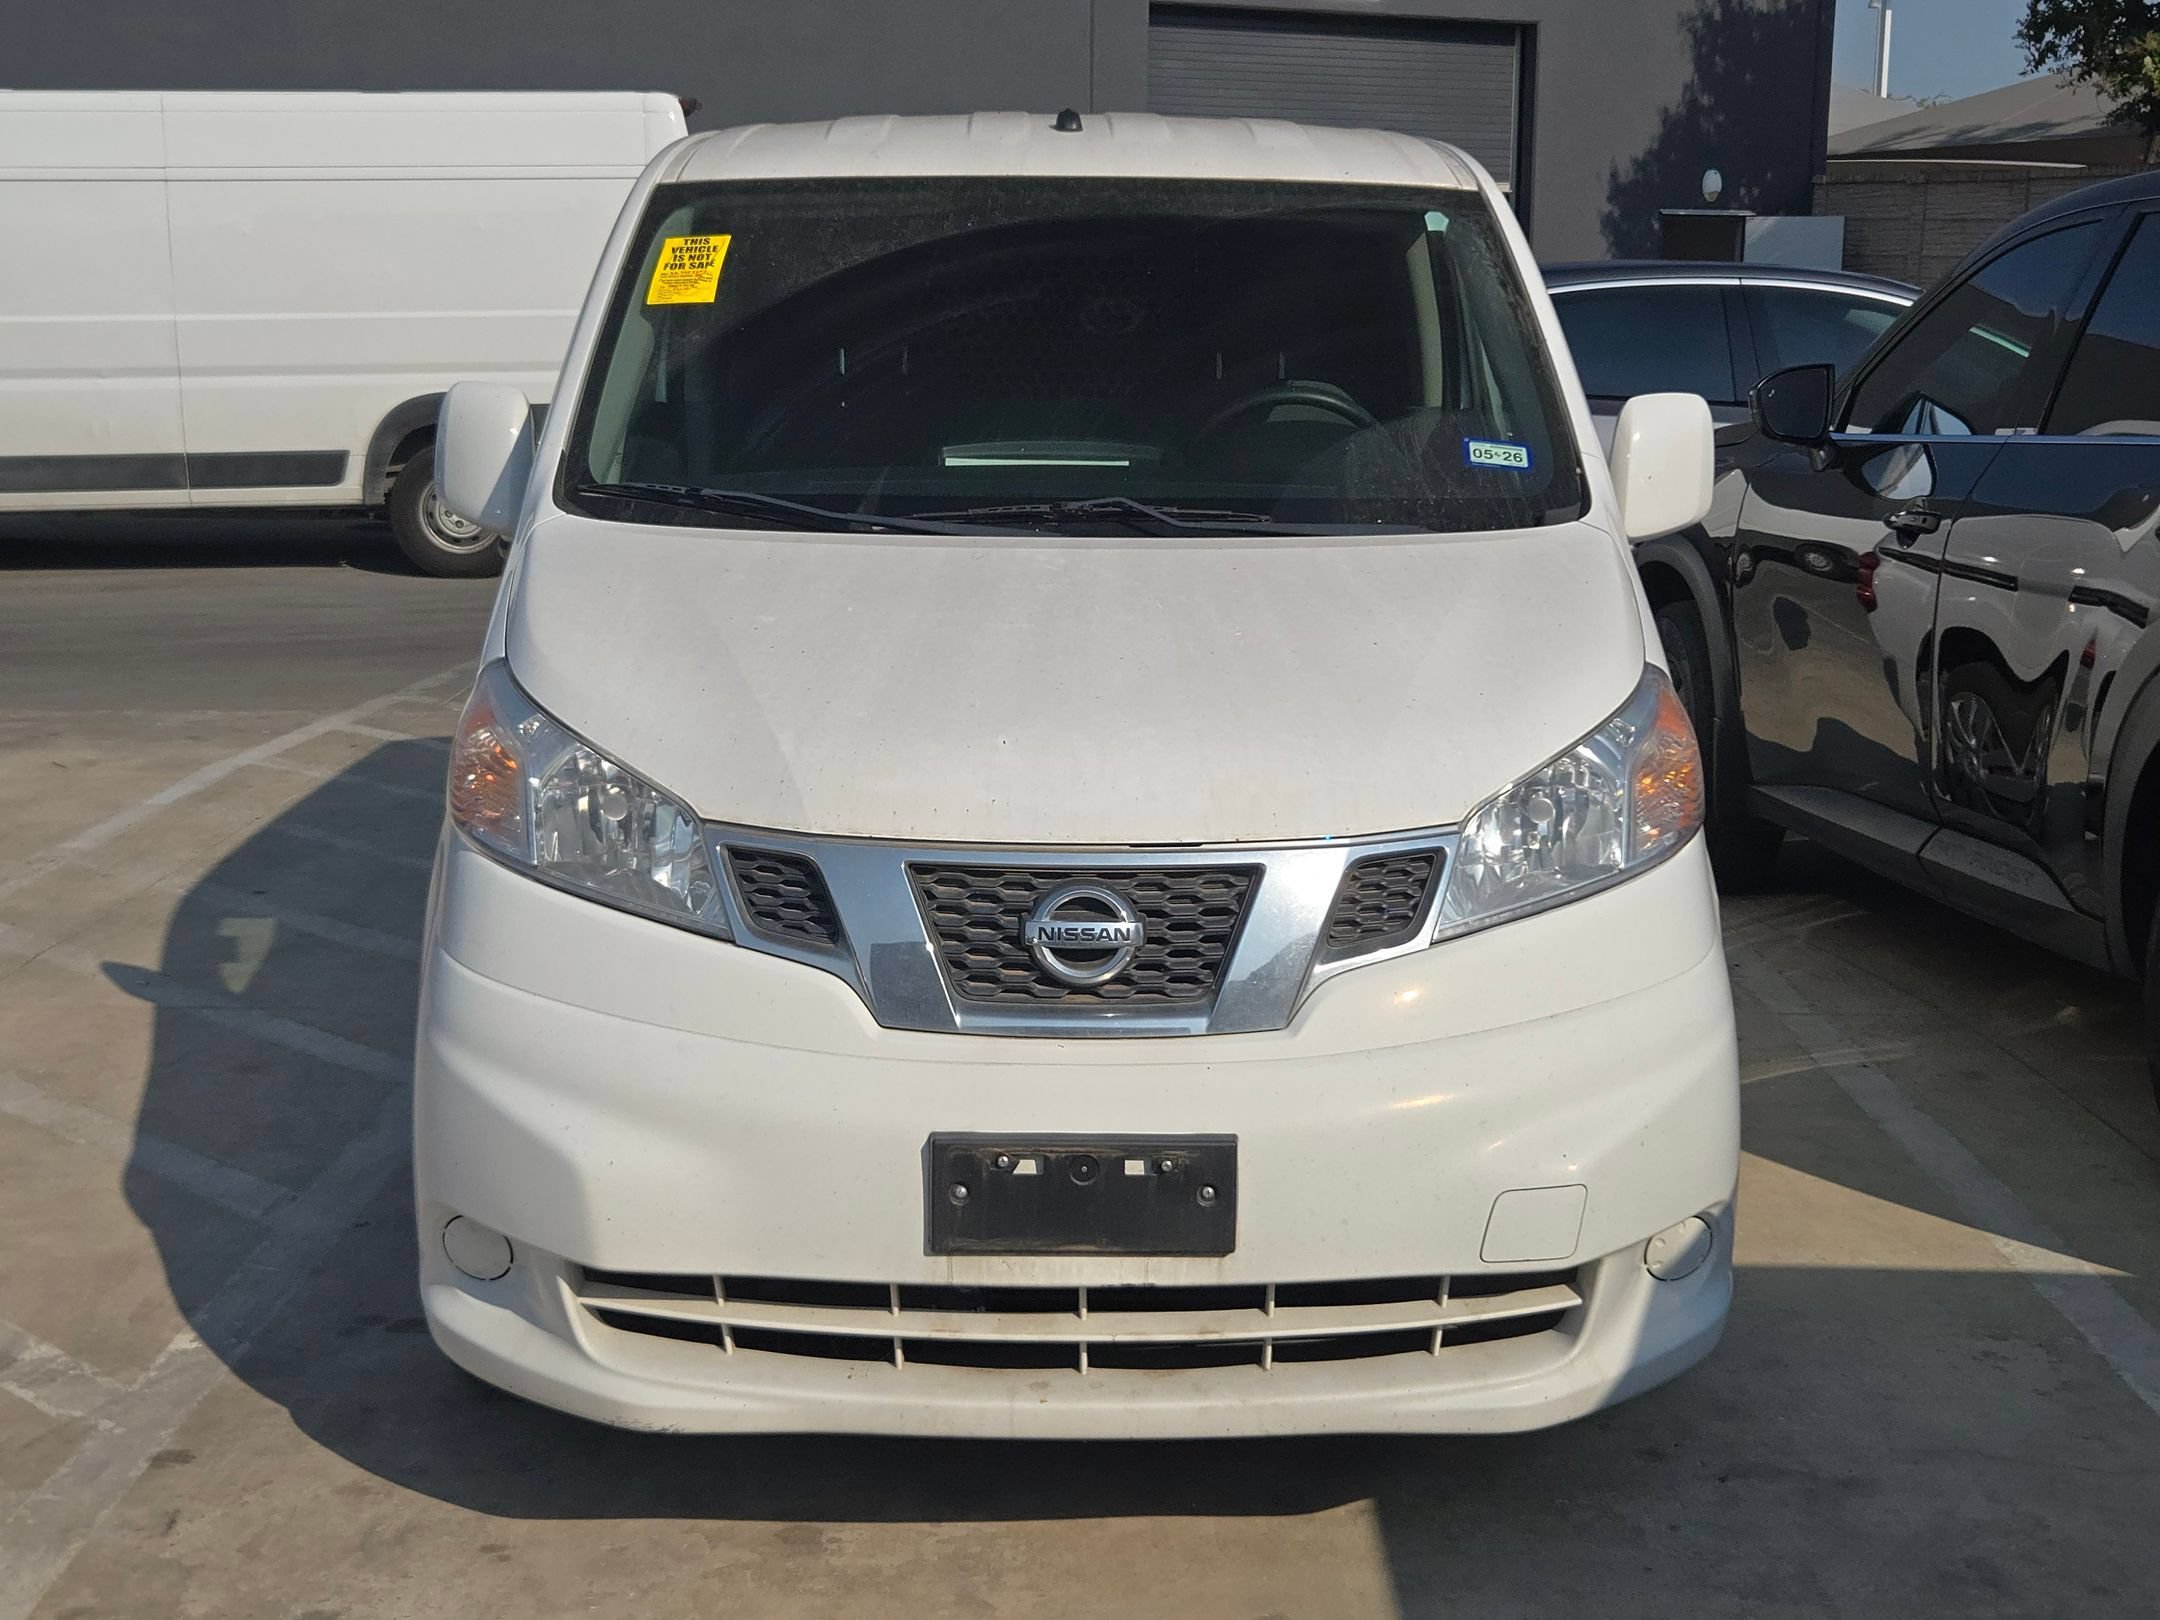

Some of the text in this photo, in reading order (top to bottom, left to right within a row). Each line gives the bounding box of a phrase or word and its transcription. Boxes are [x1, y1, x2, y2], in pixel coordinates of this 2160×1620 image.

[683, 237, 711, 246] THIS
[671, 245, 720, 254] VEHICLE
[672, 253, 713, 263] IS NOT
[663, 262, 686, 271] FOR
[1037, 926, 1131, 942] NISSAN
